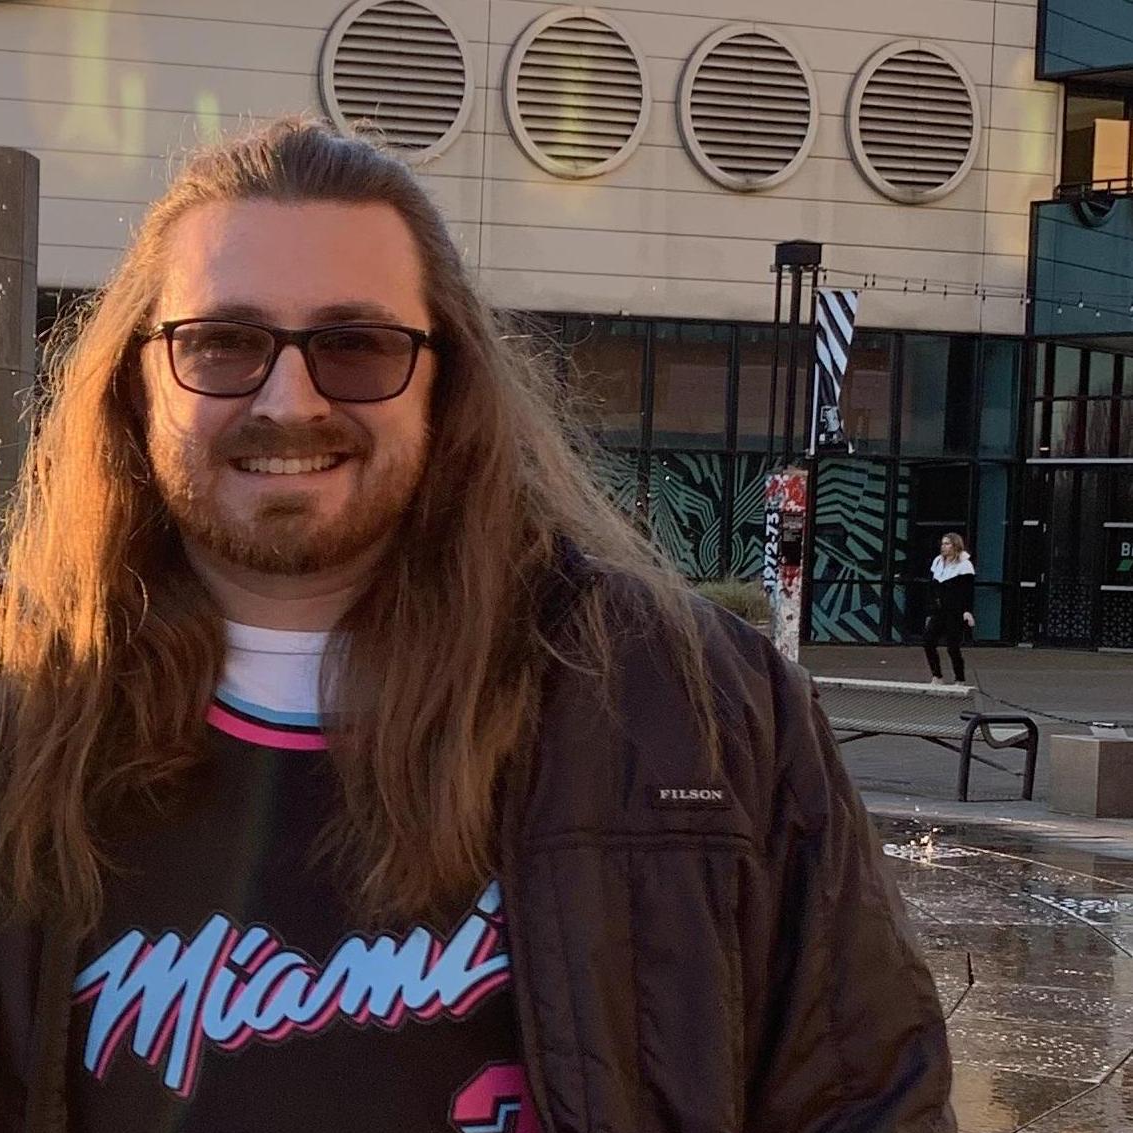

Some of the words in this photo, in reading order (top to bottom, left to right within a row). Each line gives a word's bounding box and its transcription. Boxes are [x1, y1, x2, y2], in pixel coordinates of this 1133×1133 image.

[763, 511, 780, 589] 1972-73
[659, 788, 723, 800] FILSON
[72, 878, 510, 1100] Miami
